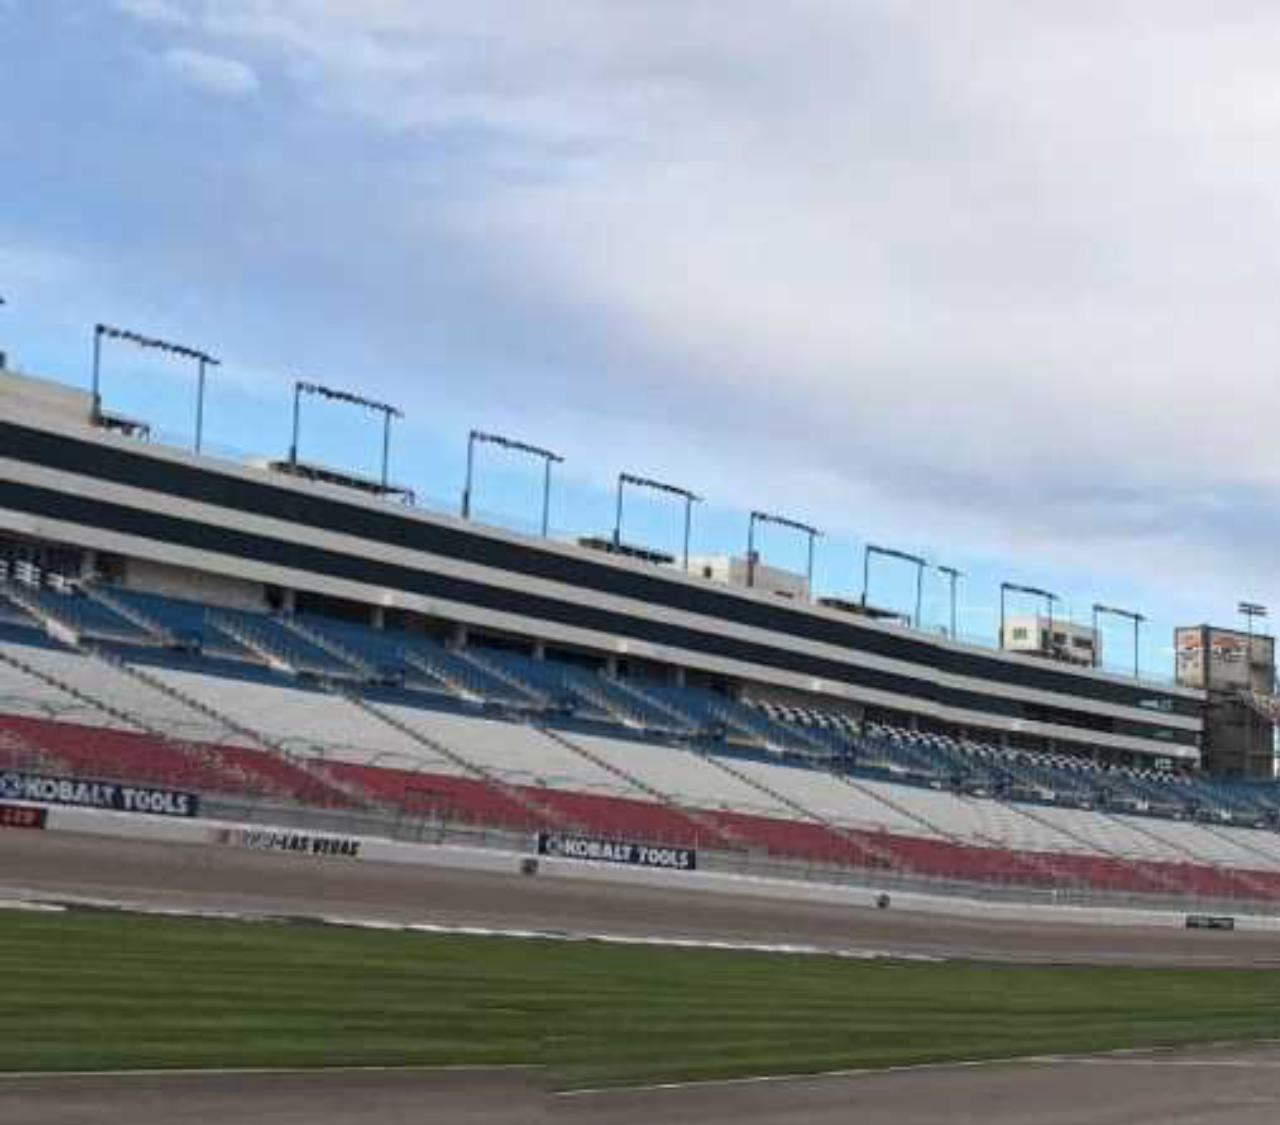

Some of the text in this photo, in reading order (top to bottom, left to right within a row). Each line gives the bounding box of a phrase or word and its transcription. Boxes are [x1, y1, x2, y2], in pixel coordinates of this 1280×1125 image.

[26, 776, 188, 814] KOBALT TOOLS
[637, 846, 689, 868] TOOLS
